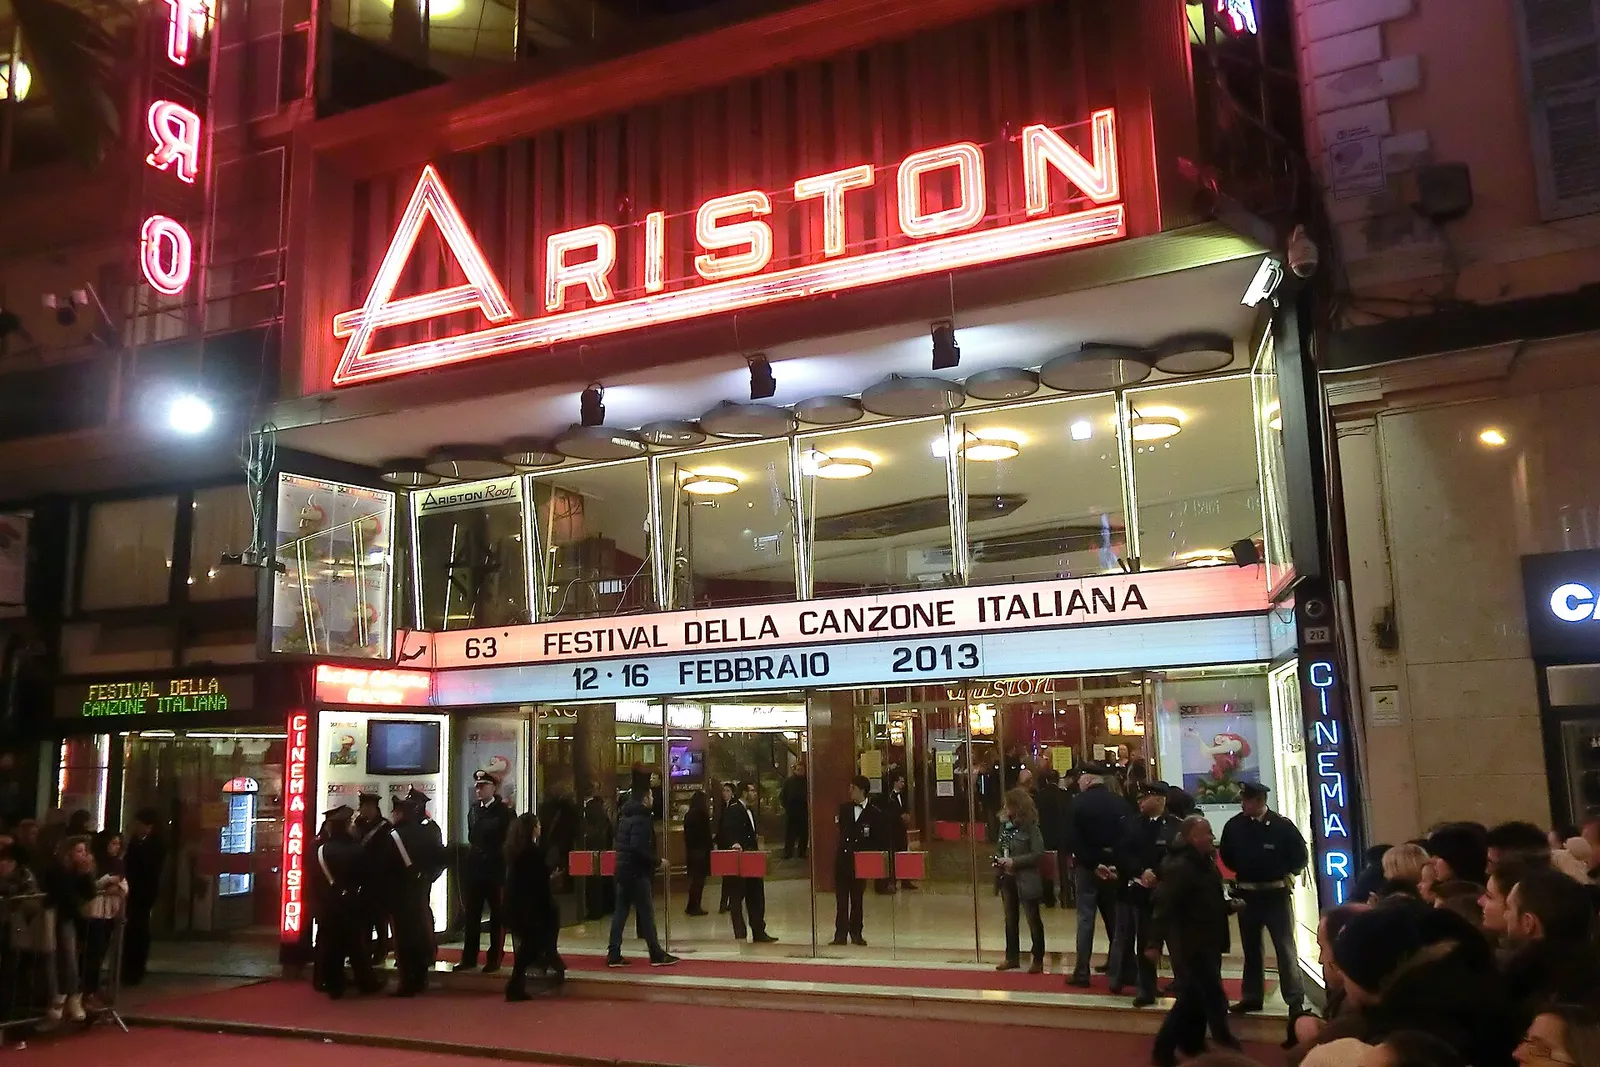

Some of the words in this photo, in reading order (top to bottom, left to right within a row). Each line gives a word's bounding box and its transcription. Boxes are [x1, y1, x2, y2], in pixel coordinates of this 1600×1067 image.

[333, 107, 1125, 386] ARISTON
[421, 492, 483, 511] ARISTON
[485, 480, 517, 500] Roof
[543, 625, 668, 656] FESTIVAL
[684, 615, 780, 646] DELLA
[799, 600, 956, 636] CANZONE
[978, 584, 1148, 623] ITALIANA
[1549, 582, 1600, 622] C
[1309, 630, 1325, 641] 212
[678, 651, 831, 685] FEBBRAIO
[892, 643, 980, 673] 2013
[82, 698, 147, 717] CANZONE
[157, 694, 229, 713] ITALIANA
[88, 681, 160, 701] FESTIVAL
[169, 677, 219, 696] DELLA
[289, 715, 307, 812] CINEMA
[1310, 662, 1348, 838] CINEMA
[284, 823, 303, 932] ARISTON
